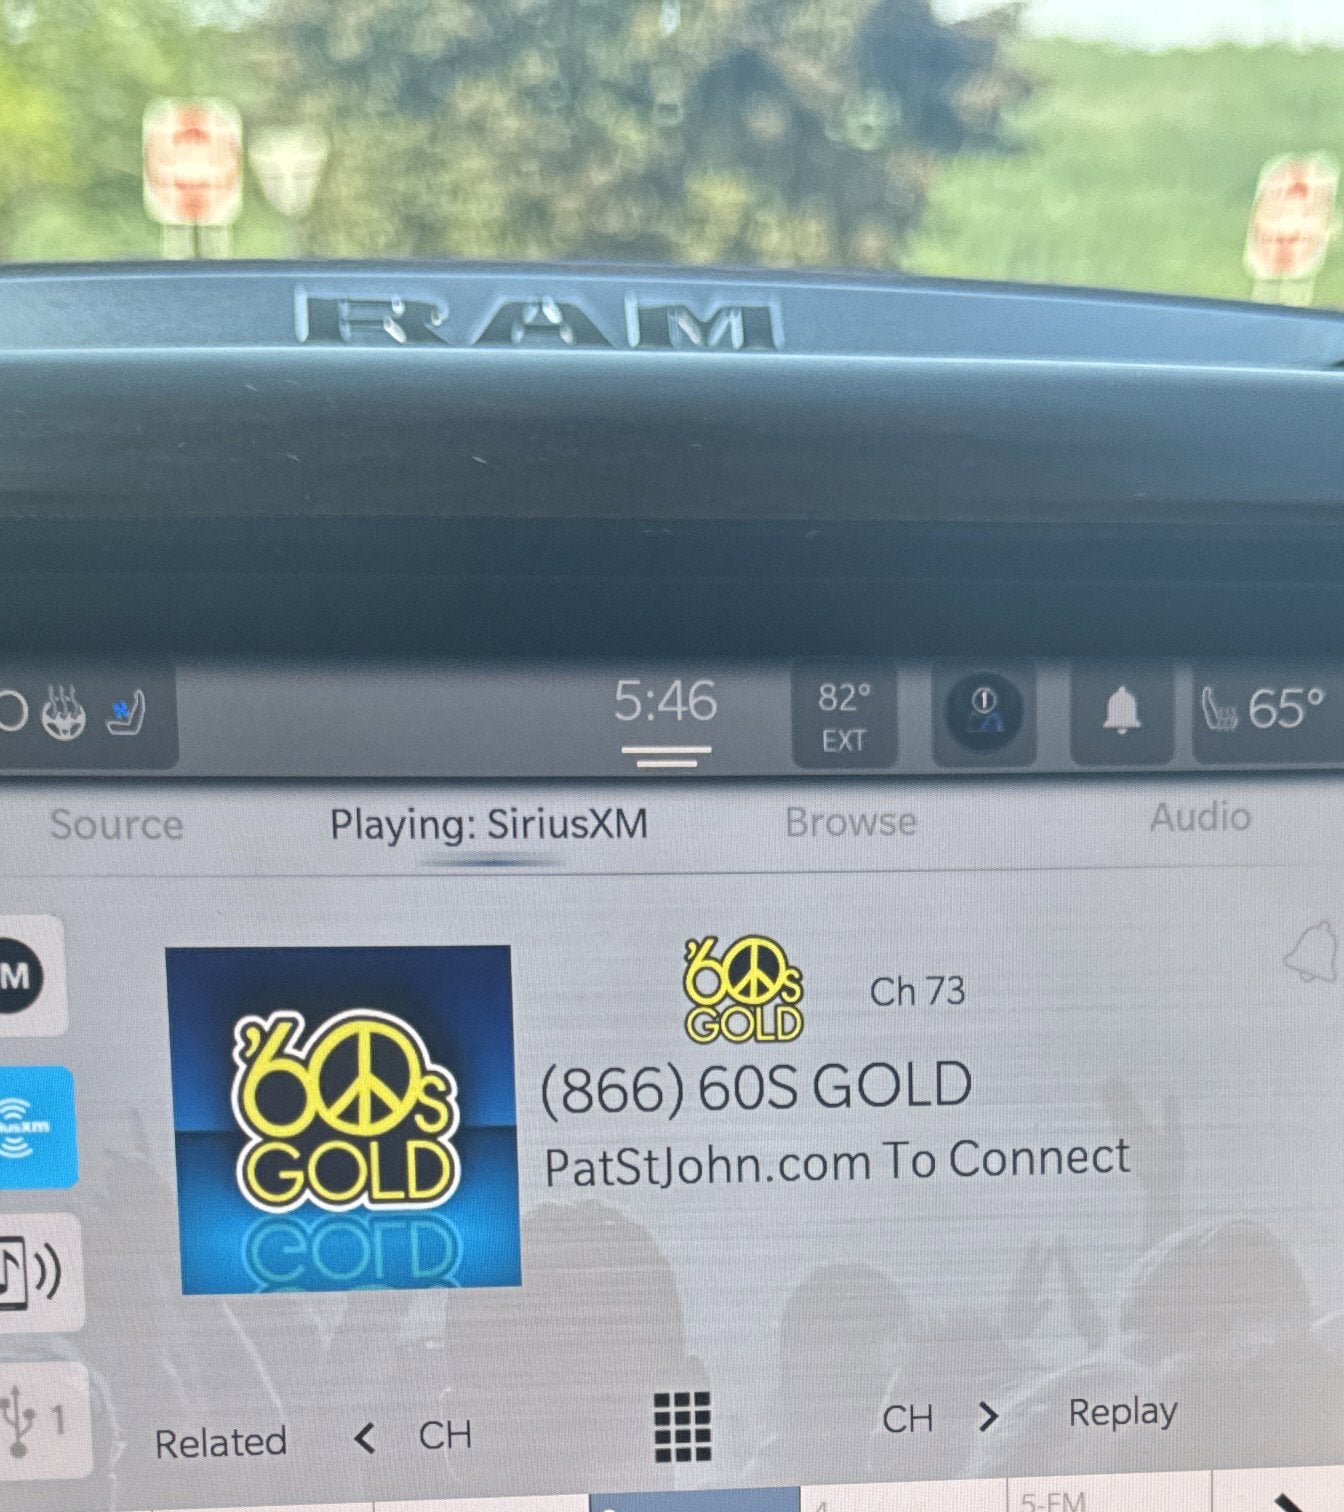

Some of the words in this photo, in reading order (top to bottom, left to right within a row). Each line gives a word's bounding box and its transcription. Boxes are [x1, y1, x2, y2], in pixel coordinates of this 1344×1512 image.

[294, 281, 786, 351] RAM
[613, 679, 719, 722] 5:46
[817, 682, 872, 713] 82°
[1247, 687, 1327, 729] 65°
[821, 727, 867, 754] EXT
[50, 808, 185, 841] Source
[330, 808, 477, 848] Playing:
[487, 807, 649, 841] SiriusXM
[785, 806, 918, 838] Browse
[1149, 800, 1252, 833] Audio
[869, 976, 916, 1008] Ch
[924, 974, 967, 1006] 73
[683, 1003, 805, 1045] GOLD
[541, 1061, 684, 1122] (866)
[698, 1063, 799, 1111] 60S
[812, 1060, 973, 1109] GOLD
[244, 1138, 454, 1204] GOLD
[545, 1144, 871, 1190] PatStJohn.com
[881, 1140, 937, 1180] To
[949, 1136, 1132, 1179] Connect
[51, 1404, 66, 1436] 1
[882, 1404, 935, 1435] CH
[1069, 1396, 1179, 1432] Replay
[156, 1425, 288, 1459] Related
[418, 1419, 474, 1451] CH
